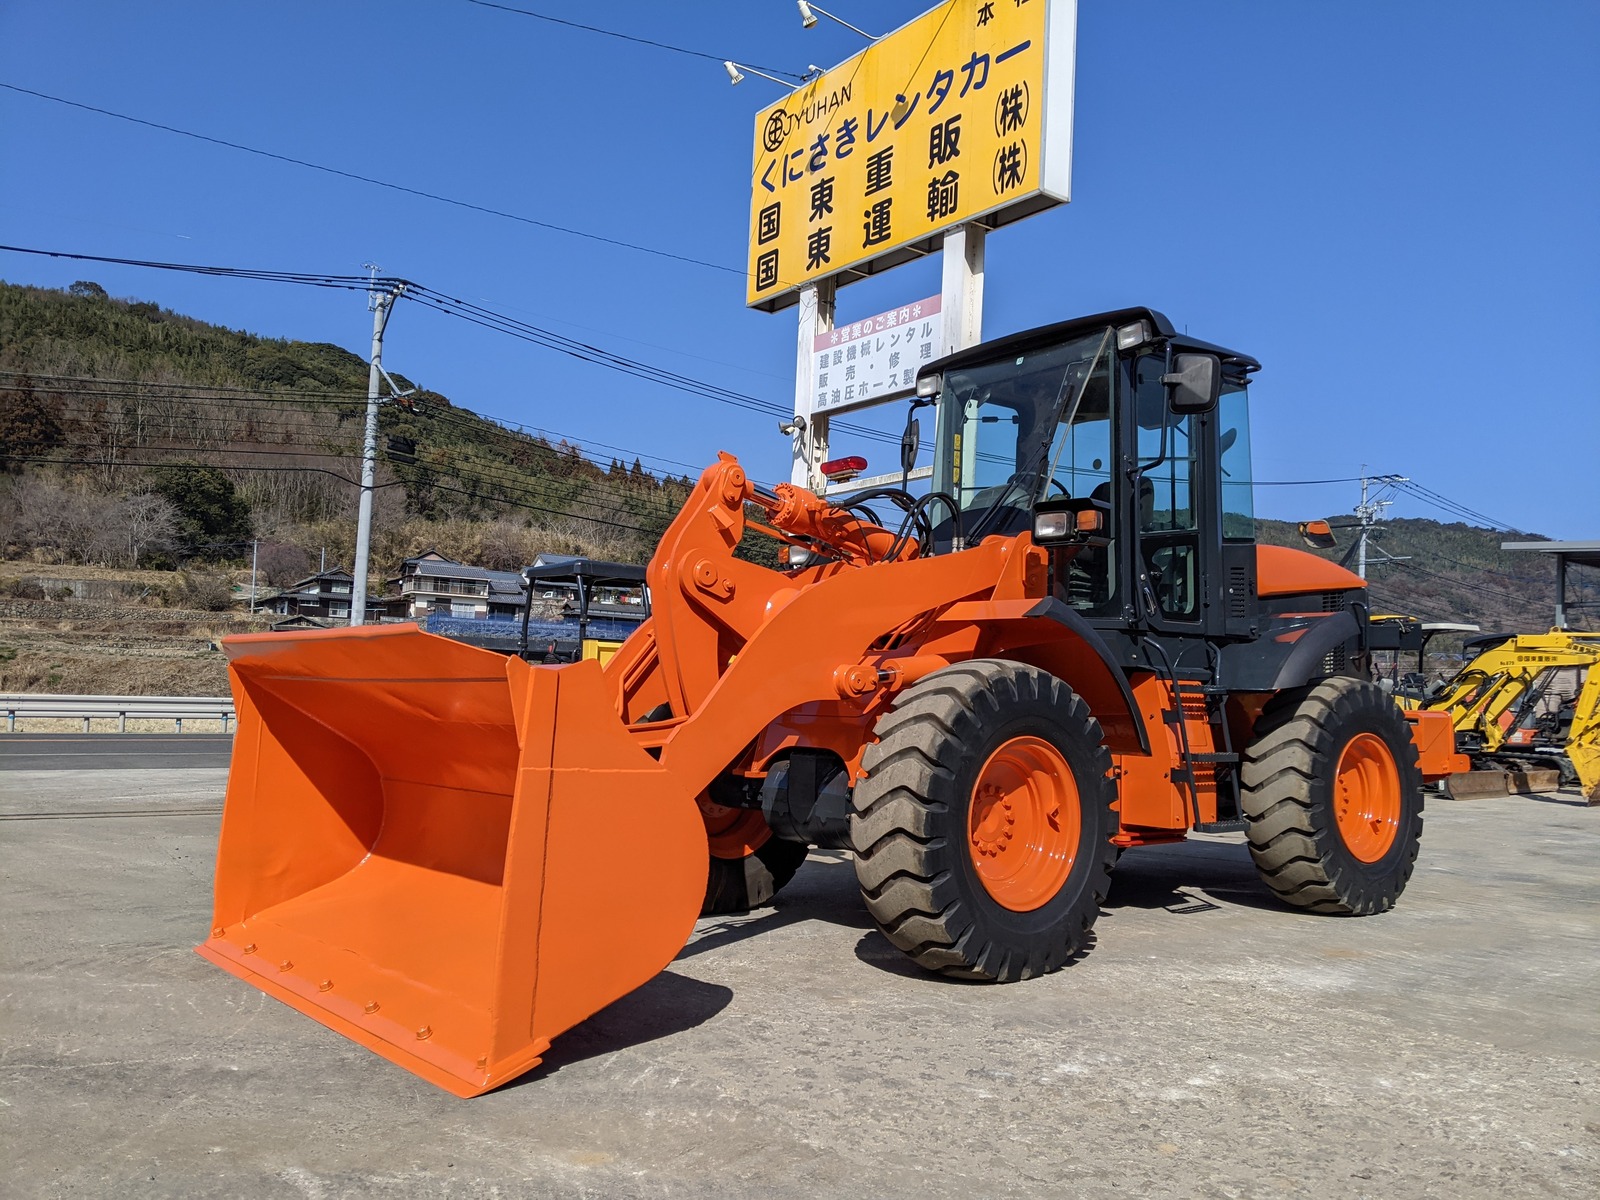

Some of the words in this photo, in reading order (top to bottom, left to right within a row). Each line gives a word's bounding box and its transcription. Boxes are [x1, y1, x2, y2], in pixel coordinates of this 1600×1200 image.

[761, 40, 1031, 193] くにさきレンタカー
[783, 82, 852, 136] JYUHAN
[819, 322, 933, 370] 建設機械レンタル
[817, 366, 922, 408] 高油圧ホース製
